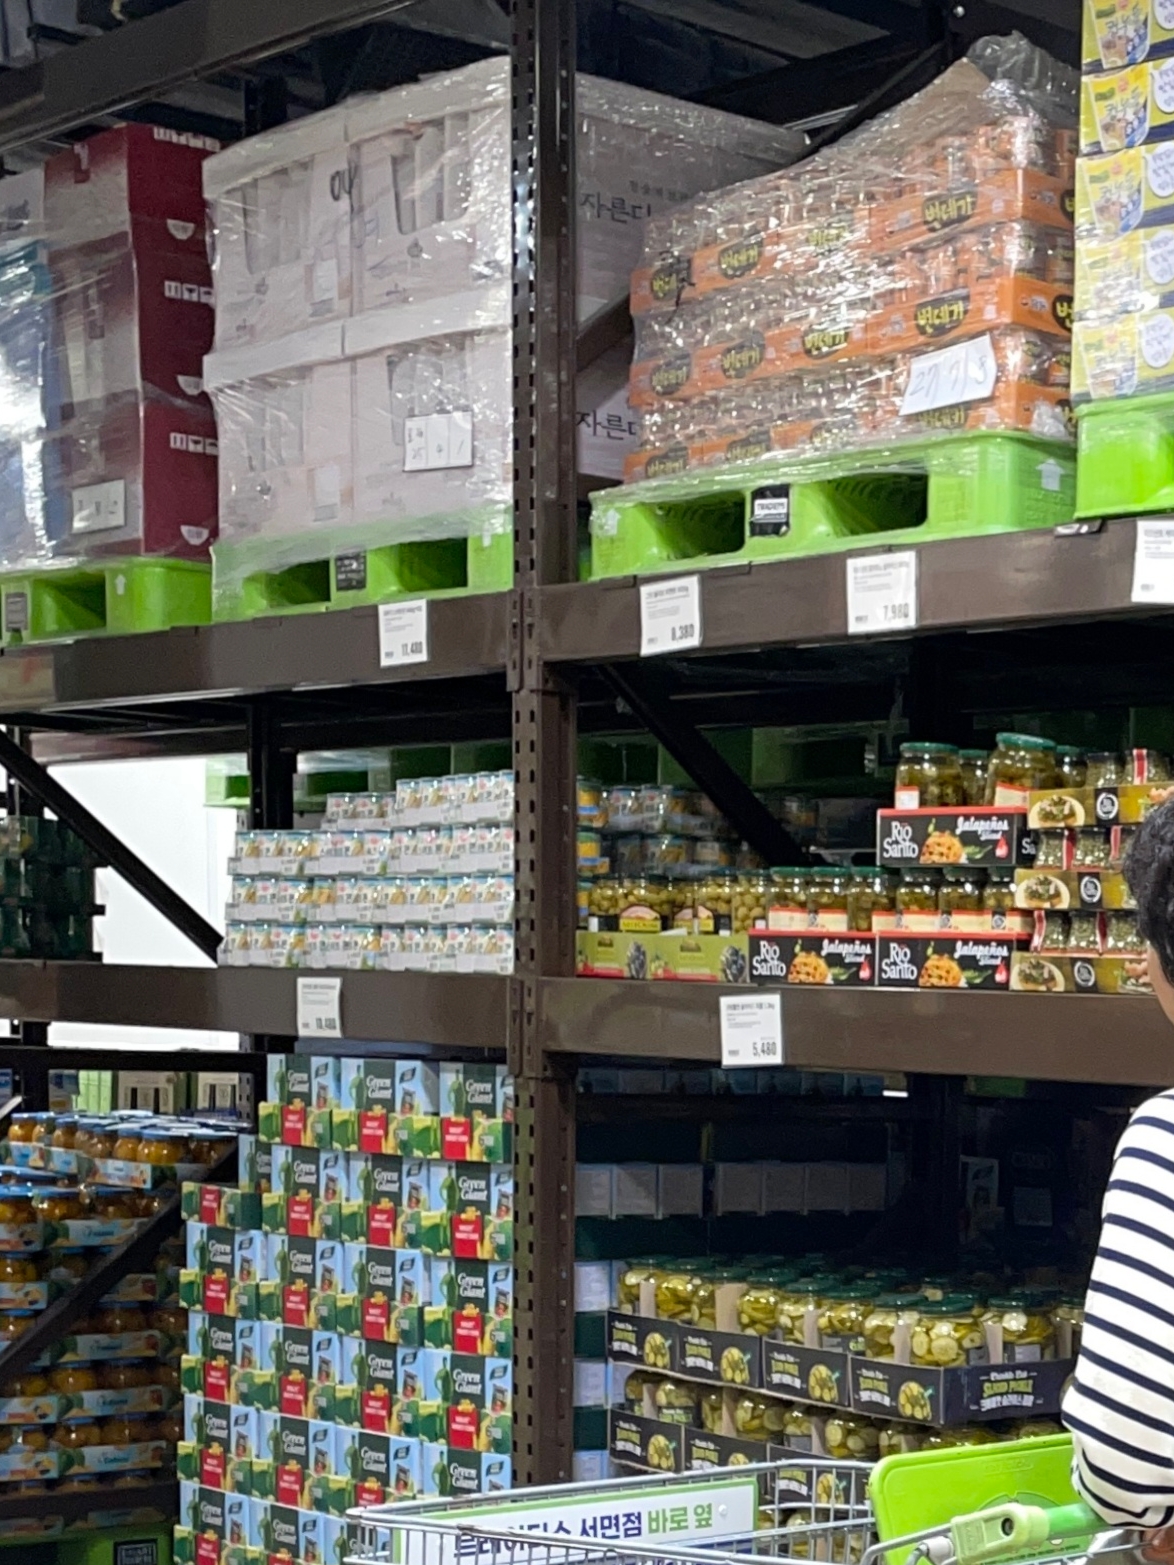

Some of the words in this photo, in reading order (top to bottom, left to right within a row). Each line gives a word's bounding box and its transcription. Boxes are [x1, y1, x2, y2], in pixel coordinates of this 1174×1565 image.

[925, 196, 972, 229] 번데기
[917, 300, 963, 334] 번데기
[956, 816, 1009, 835] Jalapeños
[883, 840, 919, 858] Santo
[821, 939, 871, 956] Jalapeños
[954, 941, 1009, 959] Jalapeños
[752, 957, 786, 977] Santo
[881, 960, 918, 979] Santo
[753, 1041, 777, 1057] 5,480
[288, 1070, 308, 1083] Green
[288, 1080, 309, 1093] Giant
[466, 1079, 492, 1094] Green
[467, 1091, 493, 1104] Giant
[294, 1161, 316, 1175] Green
[295, 1171, 317, 1184] Giant
[459, 1175, 486, 1190] Green
[460, 1187, 488, 1201] Giant
[208, 1238, 231, 1254] Green
[209, 1249, 232, 1264] Giant
[457, 1272, 484, 1289] Green
[459, 1284, 486, 1299] Giant
[453, 1369, 480, 1385] Green
[454, 1380, 482, 1395] Giant
[580, 1511, 642, 1539] 서면점
[648, 1507, 689, 1534] 바로
[693, 1503, 713, 1529] 옆
